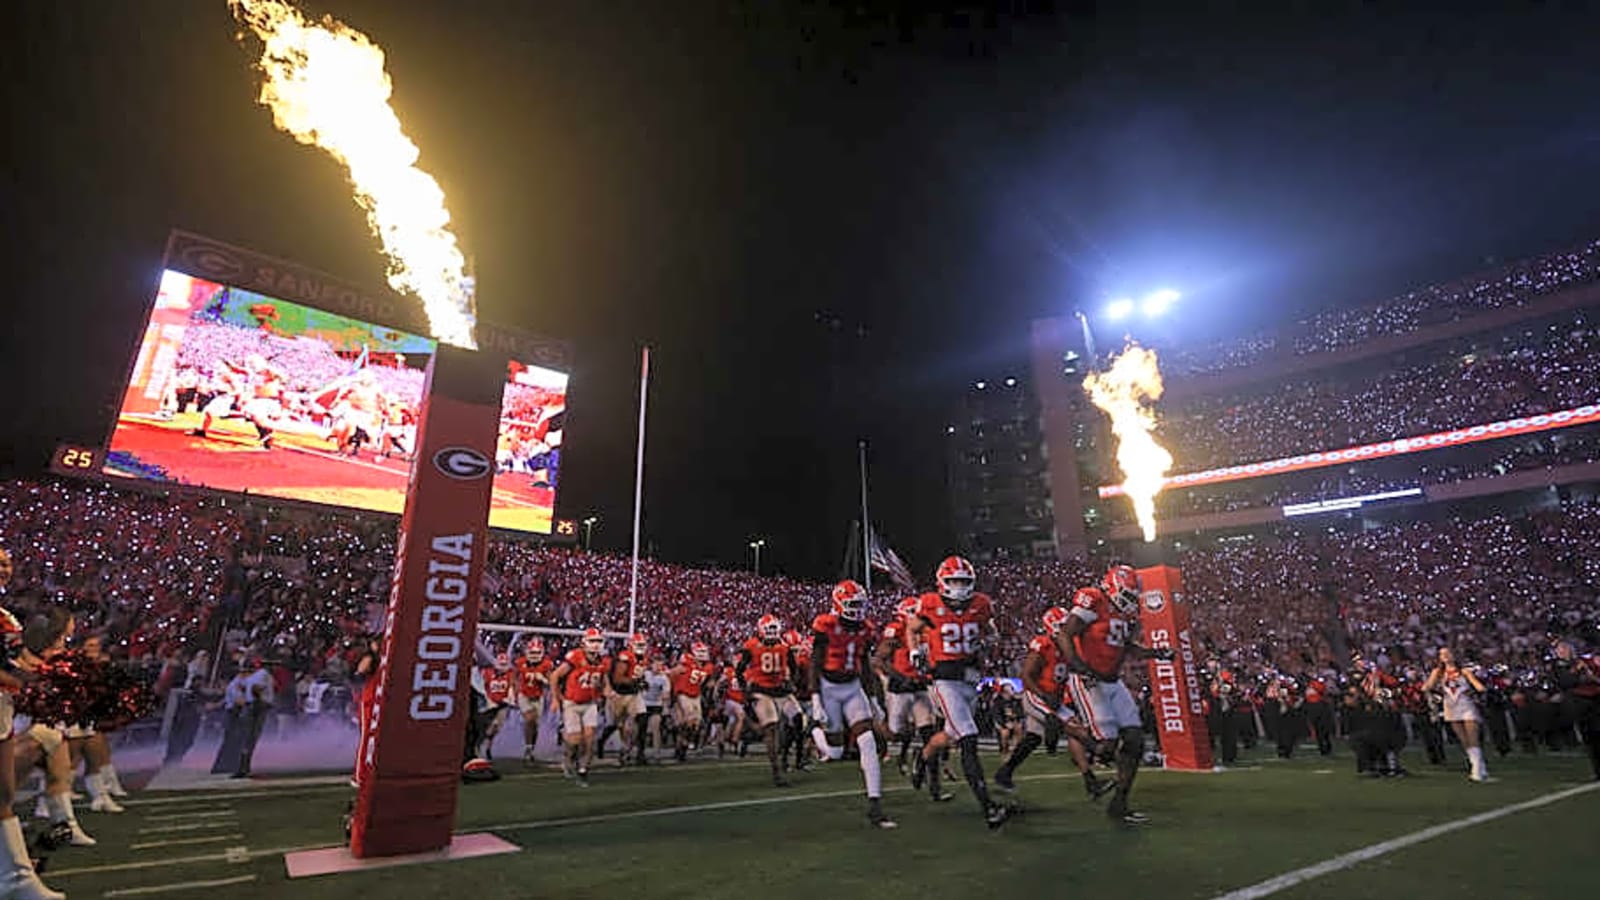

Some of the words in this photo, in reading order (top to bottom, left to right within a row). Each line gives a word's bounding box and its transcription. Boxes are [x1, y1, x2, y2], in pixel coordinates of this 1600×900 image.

[255, 266, 395, 319] SANFORD
[63, 449, 92, 468] 25
[557, 520, 574, 535] 25
[410, 532, 474, 721] GEORGIA
[760, 652, 781, 674] 81
[845, 642, 856, 670] 1
[1178, 630, 1202, 714] GEORGIA
